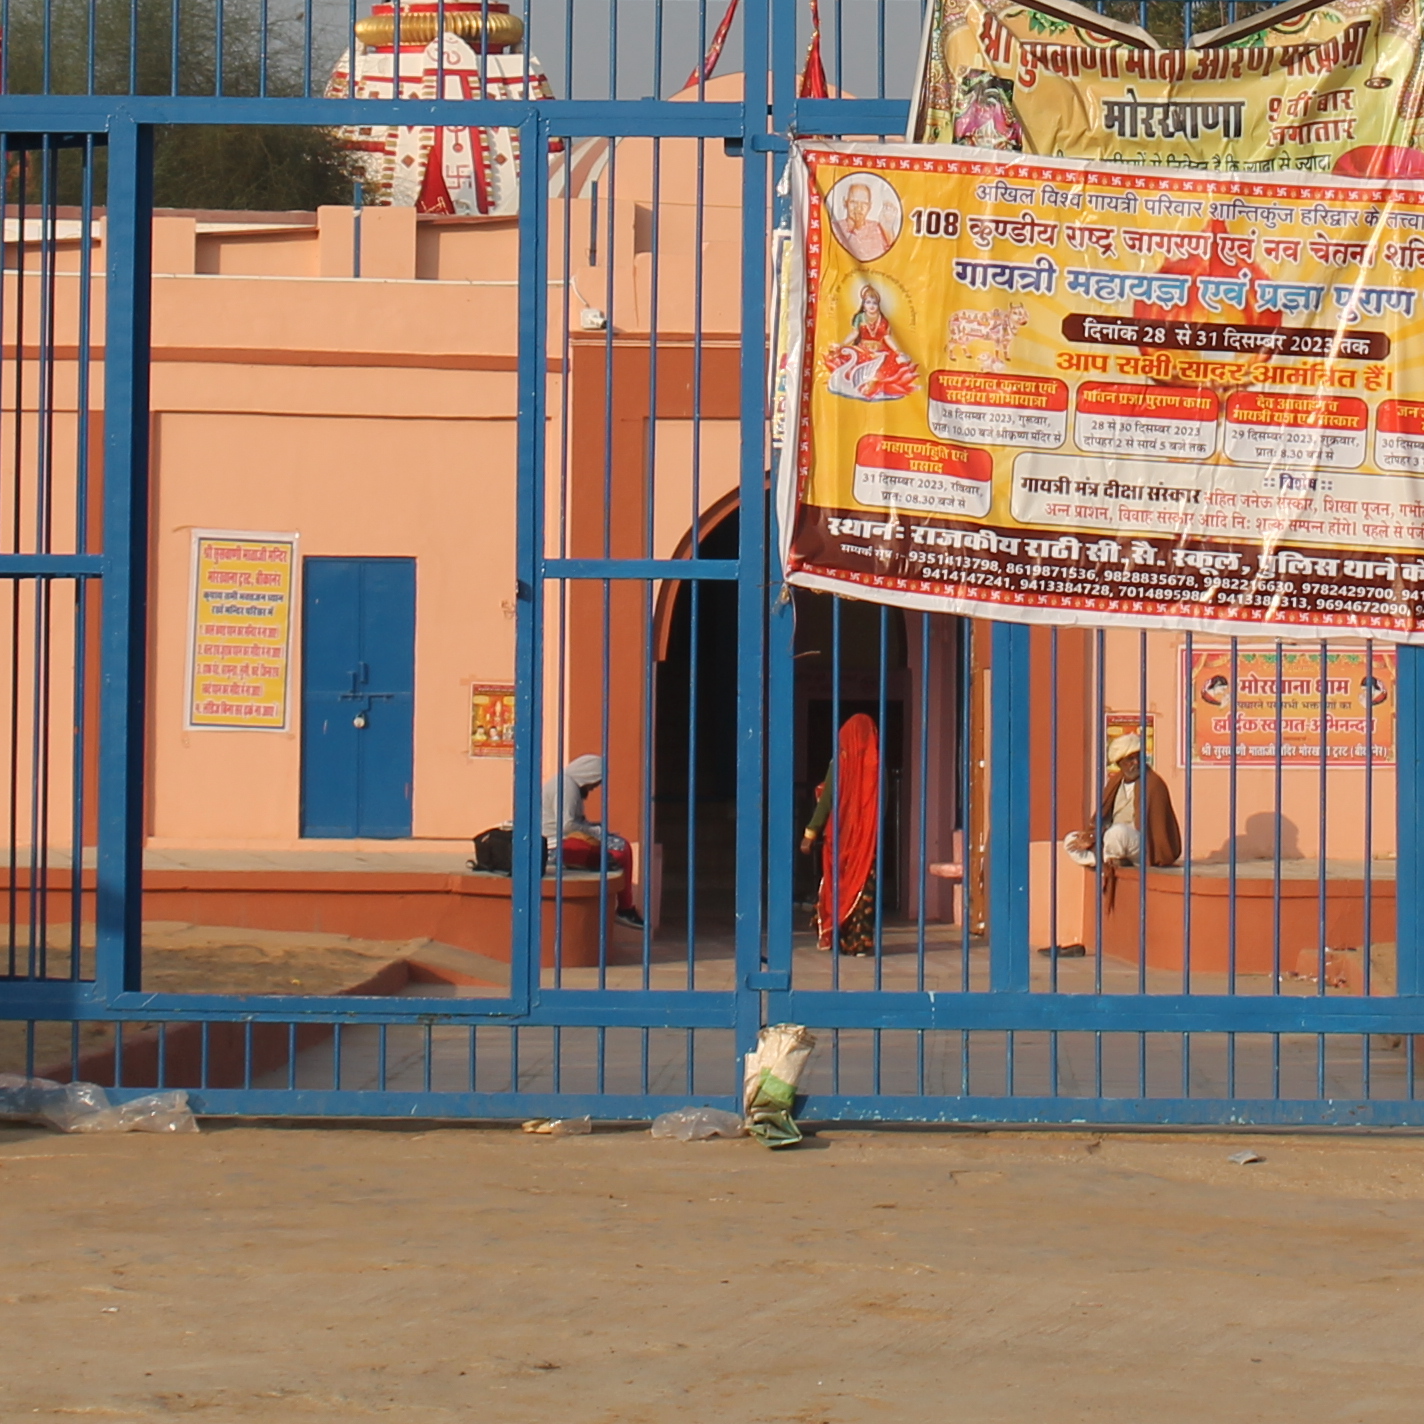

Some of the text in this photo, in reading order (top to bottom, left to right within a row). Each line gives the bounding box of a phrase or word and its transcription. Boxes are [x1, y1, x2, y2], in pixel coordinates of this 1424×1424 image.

[1101, 88, 1245, 139] मोरखाणा
[1318, 89, 1355, 112] बार
[976, 181, 1034, 206] अखिल
[1041, 184, 1083, 209] विश्व
[1088, 186, 1138, 215] गायत्री
[1144, 195, 1203, 218] परिवार
[1209, 199, 1294, 229] शान्तिकुंज
[1300, 203, 1359, 227] हरिद्वार
[1364, 206, 1381, 227] के
[909, 208, 960, 238] 108
[969, 212, 1058, 249] कुण्डीय
[1066, 225, 1116, 258] राष्ट्र
[1122, 230, 1212, 258] जागरण
[1218, 230, 1257, 265] एवं
[1263, 239, 1302, 263] नव
[954, 256, 1056, 294] गायत्री
[1067, 269, 1190, 308] महायज्ञ
[1198, 270, 1250, 312] एवं
[1256, 280, 1325, 313] प्रज्ञा
[1334, 284, 1416, 322] पुराण
[1083, 317, 1371, 356] दिनांक 28 से 31 दिसम्बर 2023 तक
[1056, 351, 1111, 373] आप
[1116, 351, 1171, 379] सभी
[1177, 359, 1245, 383] सादर
[1251, 357, 1357, 390] आमंत्रित
[942, 408, 953, 419] 28
[955, 408, 987, 423] दिसम्बर
[952, 426, 976, 437] 10.00
[1091, 418, 1201, 437] 28 से 30 दिसम्बर 2023
[1382, 438, 1394, 448] 30
[862, 473, 947, 491] 31 दिसम्बर 2023,
[905, 494, 935, 506] 08.30
[1021, 476, 1070, 496] गायत्री
[1075, 476, 1098, 498] मंत्र
[1103, 479, 1144, 501] दीक्षा
[1147, 482, 1202, 505] संस्कार
[1240, 491, 1273, 508] जनेऊ
[1324, 495, 1357, 514] शिखा
[1045, 502, 1070, 517] अन्न
[1118, 507, 1153, 524] विवाह
[1156, 509, 1195, 526] संस्कार
[1199, 512, 1228, 527] आदि
[1363, 521, 1389, 539] पहले
[1393, 522, 1404, 539] से
[911, 524, 1020, 557] राजकीय
[1027, 534, 1080, 560] राठी
[1343, 558, 1397, 582] थाने
[922, 568, 1015, 590] 9414147241,
[1019, 578, 1113, 599] 9413384728,
[1006, 562, 1099, 582] 8619871536,
[1104, 569, 1198, 589] 9828835678,
[1302, 582, 1397, 601] 9782429700,
